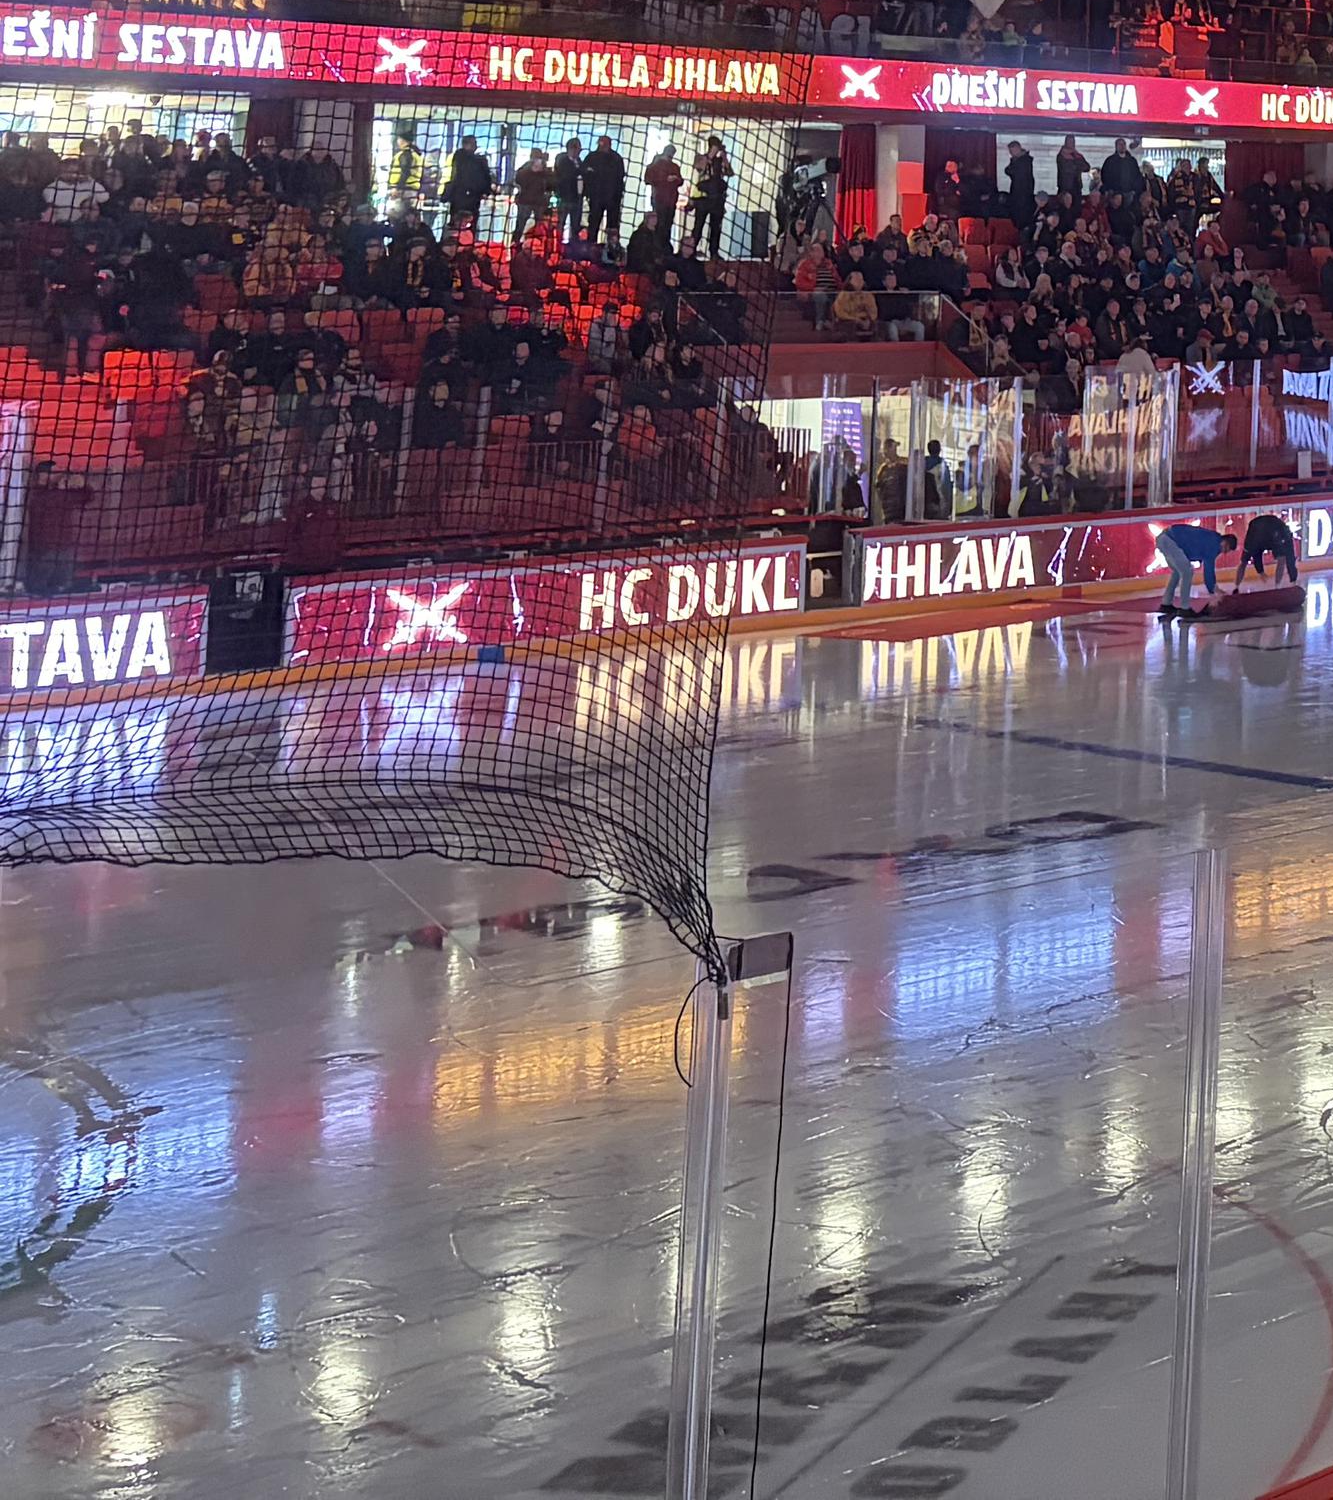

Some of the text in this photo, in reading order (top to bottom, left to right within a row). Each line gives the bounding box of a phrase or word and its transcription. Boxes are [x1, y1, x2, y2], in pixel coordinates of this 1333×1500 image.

[118, 23, 284, 70] SESTAVA
[489, 47, 779, 95] HC DUKLA JIHLAVA
[932, 70, 1137, 114] DNEŠNÍ SESTAVA
[1262, 94, 1290, 121] HC
[863, 533, 1036, 601] JIHLAVA
[580, 557, 797, 630] HC DUKL
[0, 612, 171, 688] TAVA
